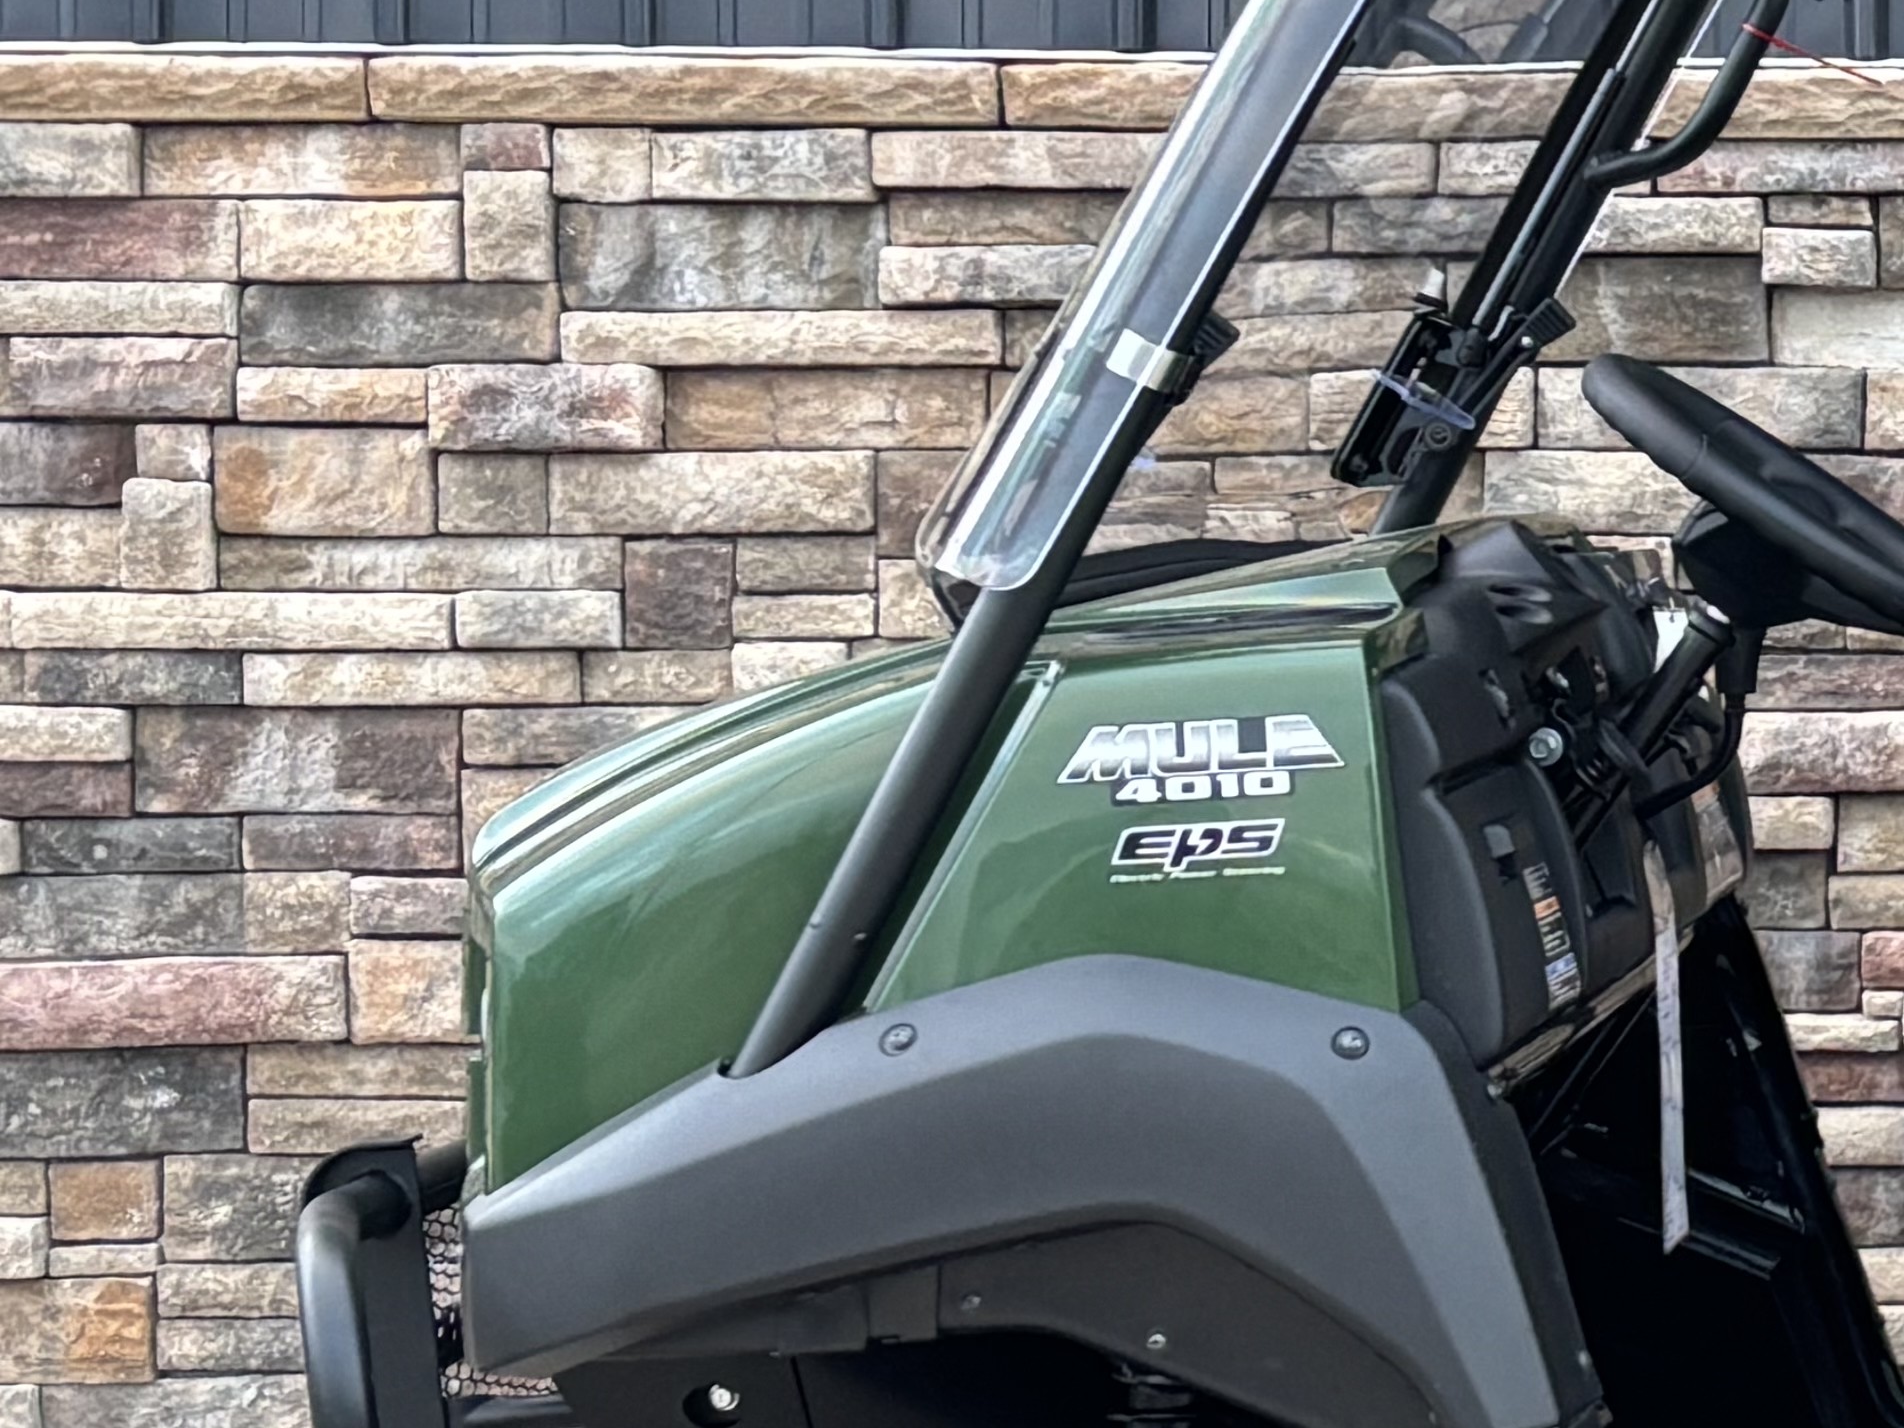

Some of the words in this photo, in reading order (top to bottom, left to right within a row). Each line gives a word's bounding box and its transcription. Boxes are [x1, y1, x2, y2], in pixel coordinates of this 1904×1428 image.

[1057, 714, 1345, 784] MULE
[1115, 771, 1291, 803] 4010
[1112, 819, 1286, 872] EPS
